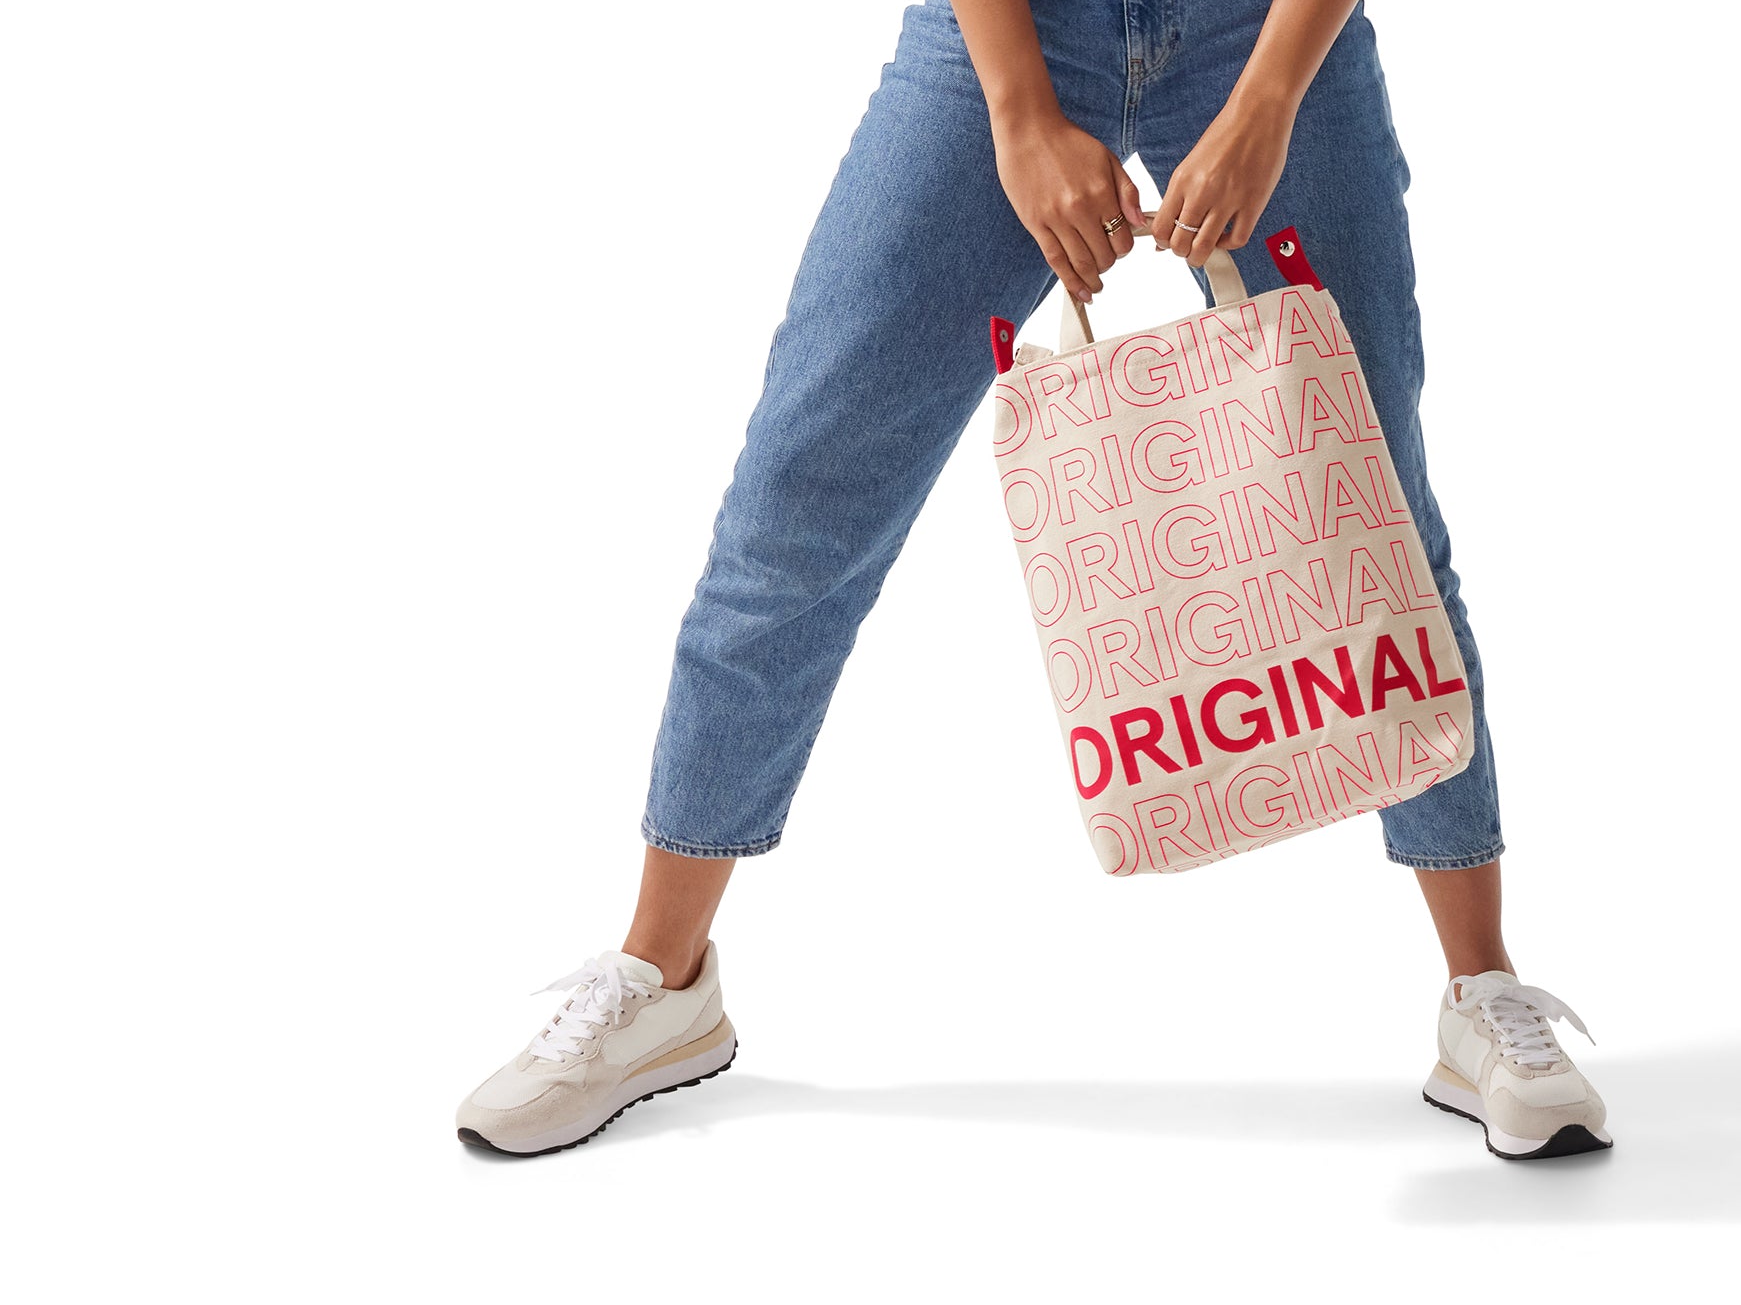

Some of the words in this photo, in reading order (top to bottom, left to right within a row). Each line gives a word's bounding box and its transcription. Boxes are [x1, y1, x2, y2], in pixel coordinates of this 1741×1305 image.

[1001, 371, 1383, 543] ORIGINAL
[1024, 456, 1410, 627] ORIGINAL
[1046, 540, 1438, 713] ORIGINAL
[1070, 626, 1466, 800] ORIGINAL
